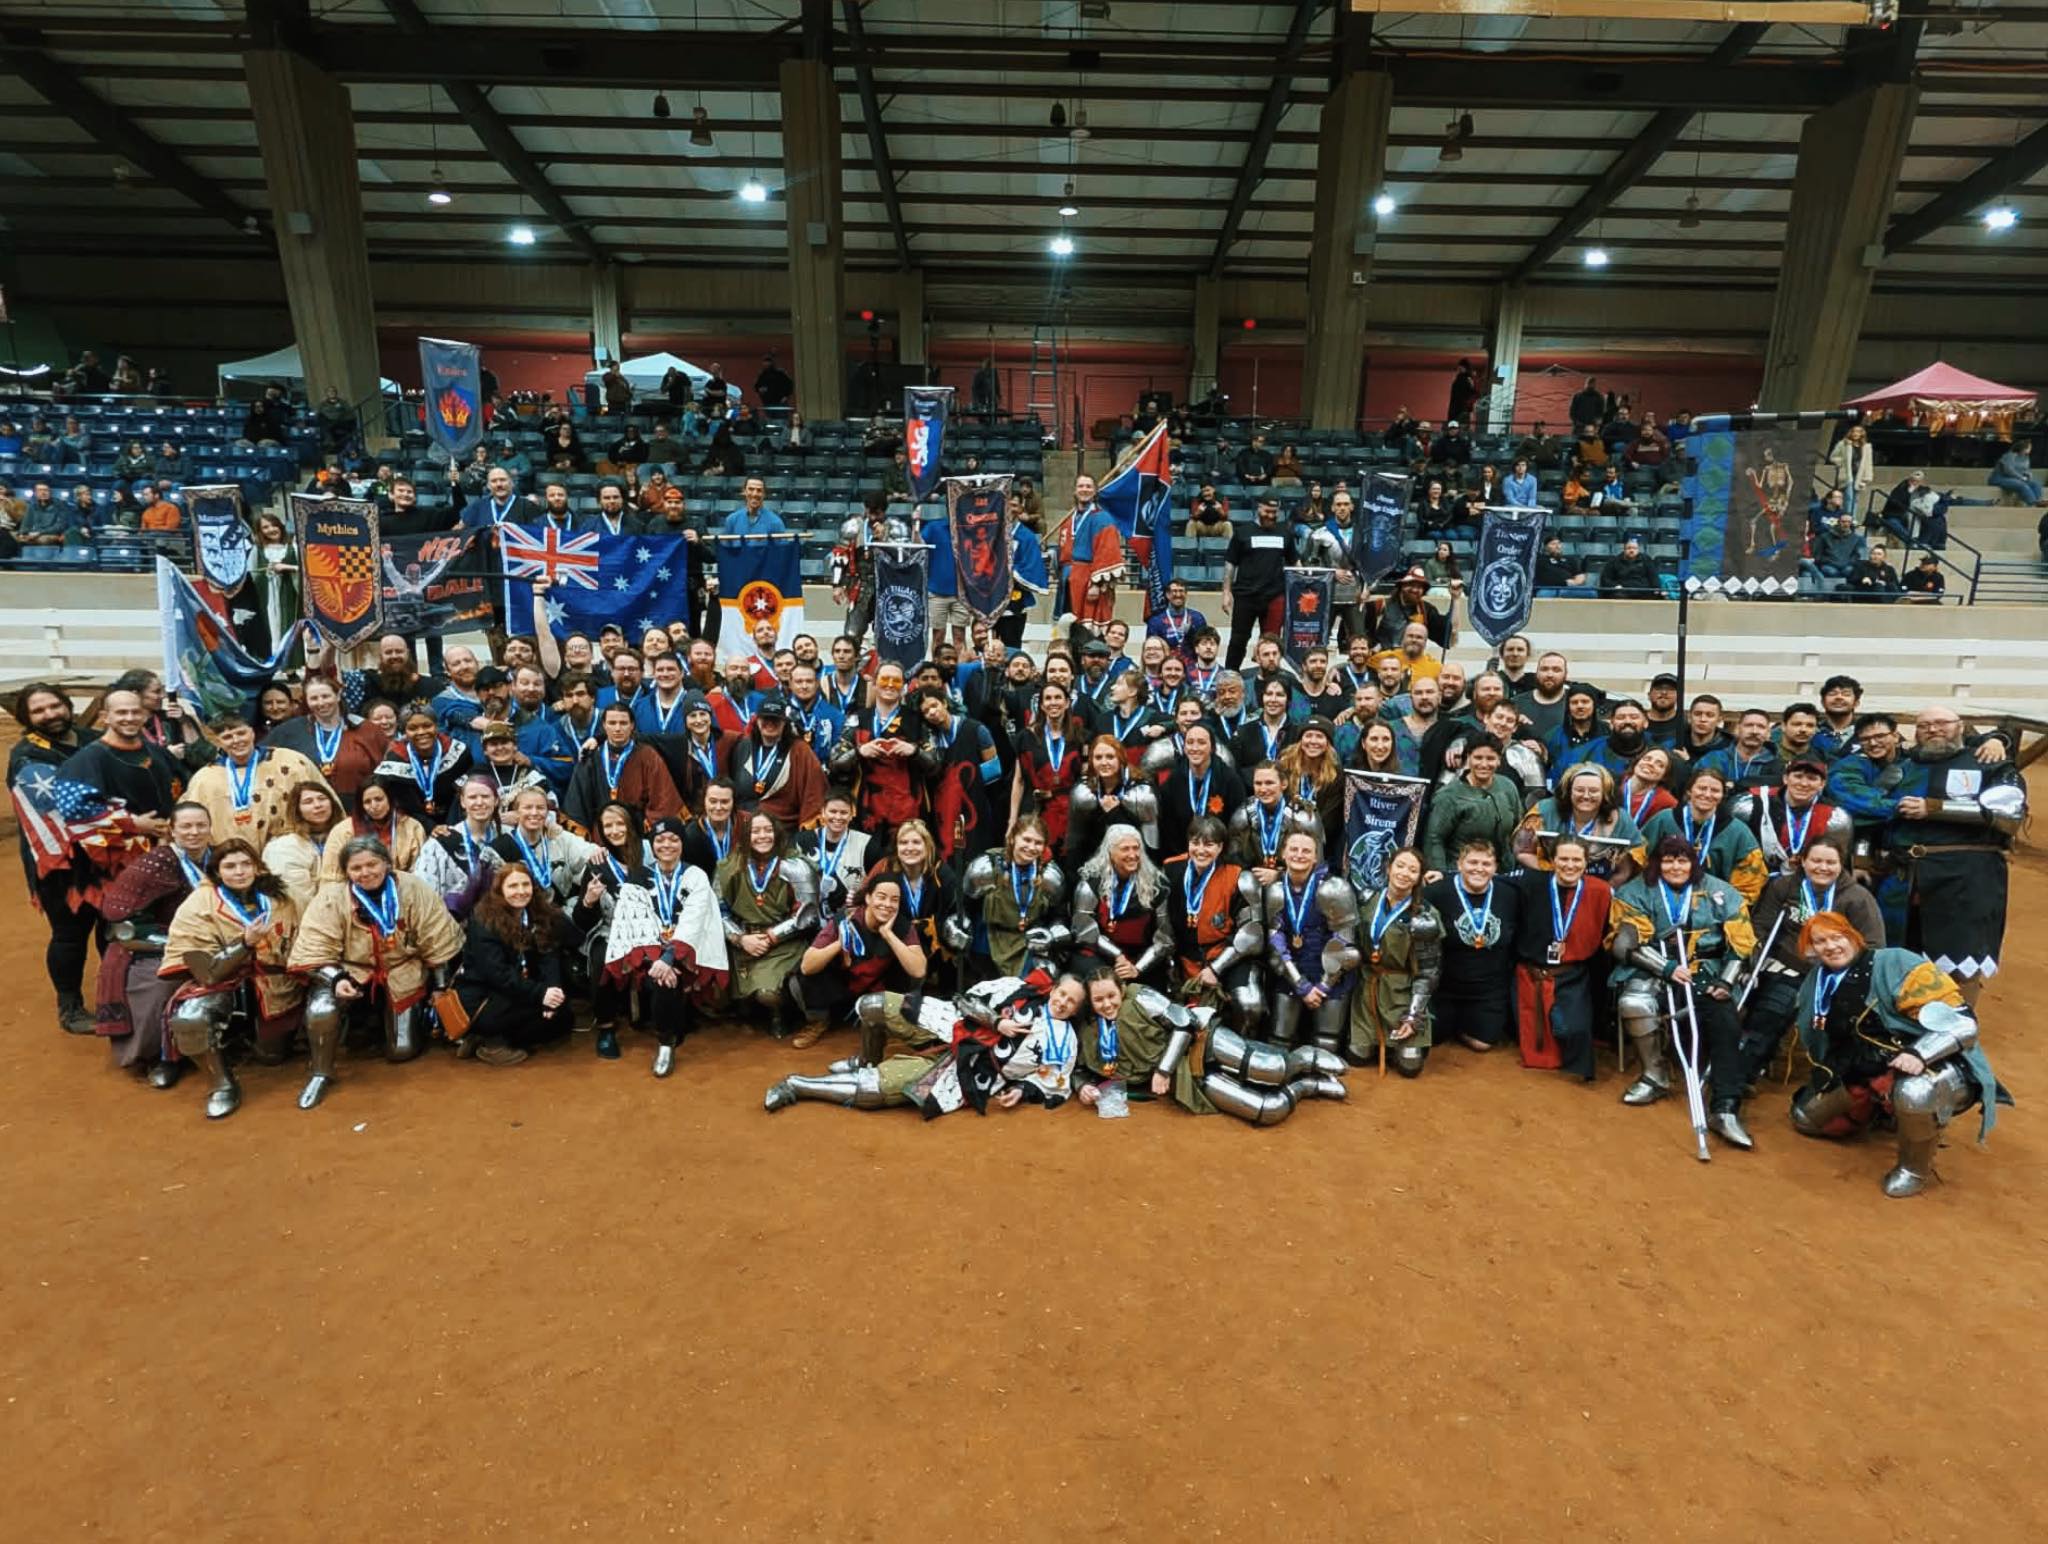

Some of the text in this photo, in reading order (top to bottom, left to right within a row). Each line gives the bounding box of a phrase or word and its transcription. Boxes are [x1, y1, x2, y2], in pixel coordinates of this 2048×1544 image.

[316, 522, 359, 536] Mythics
[1497, 543, 1522, 556] Order
[1369, 797, 1399, 811] River
[1364, 813, 1398, 829] Sirens
